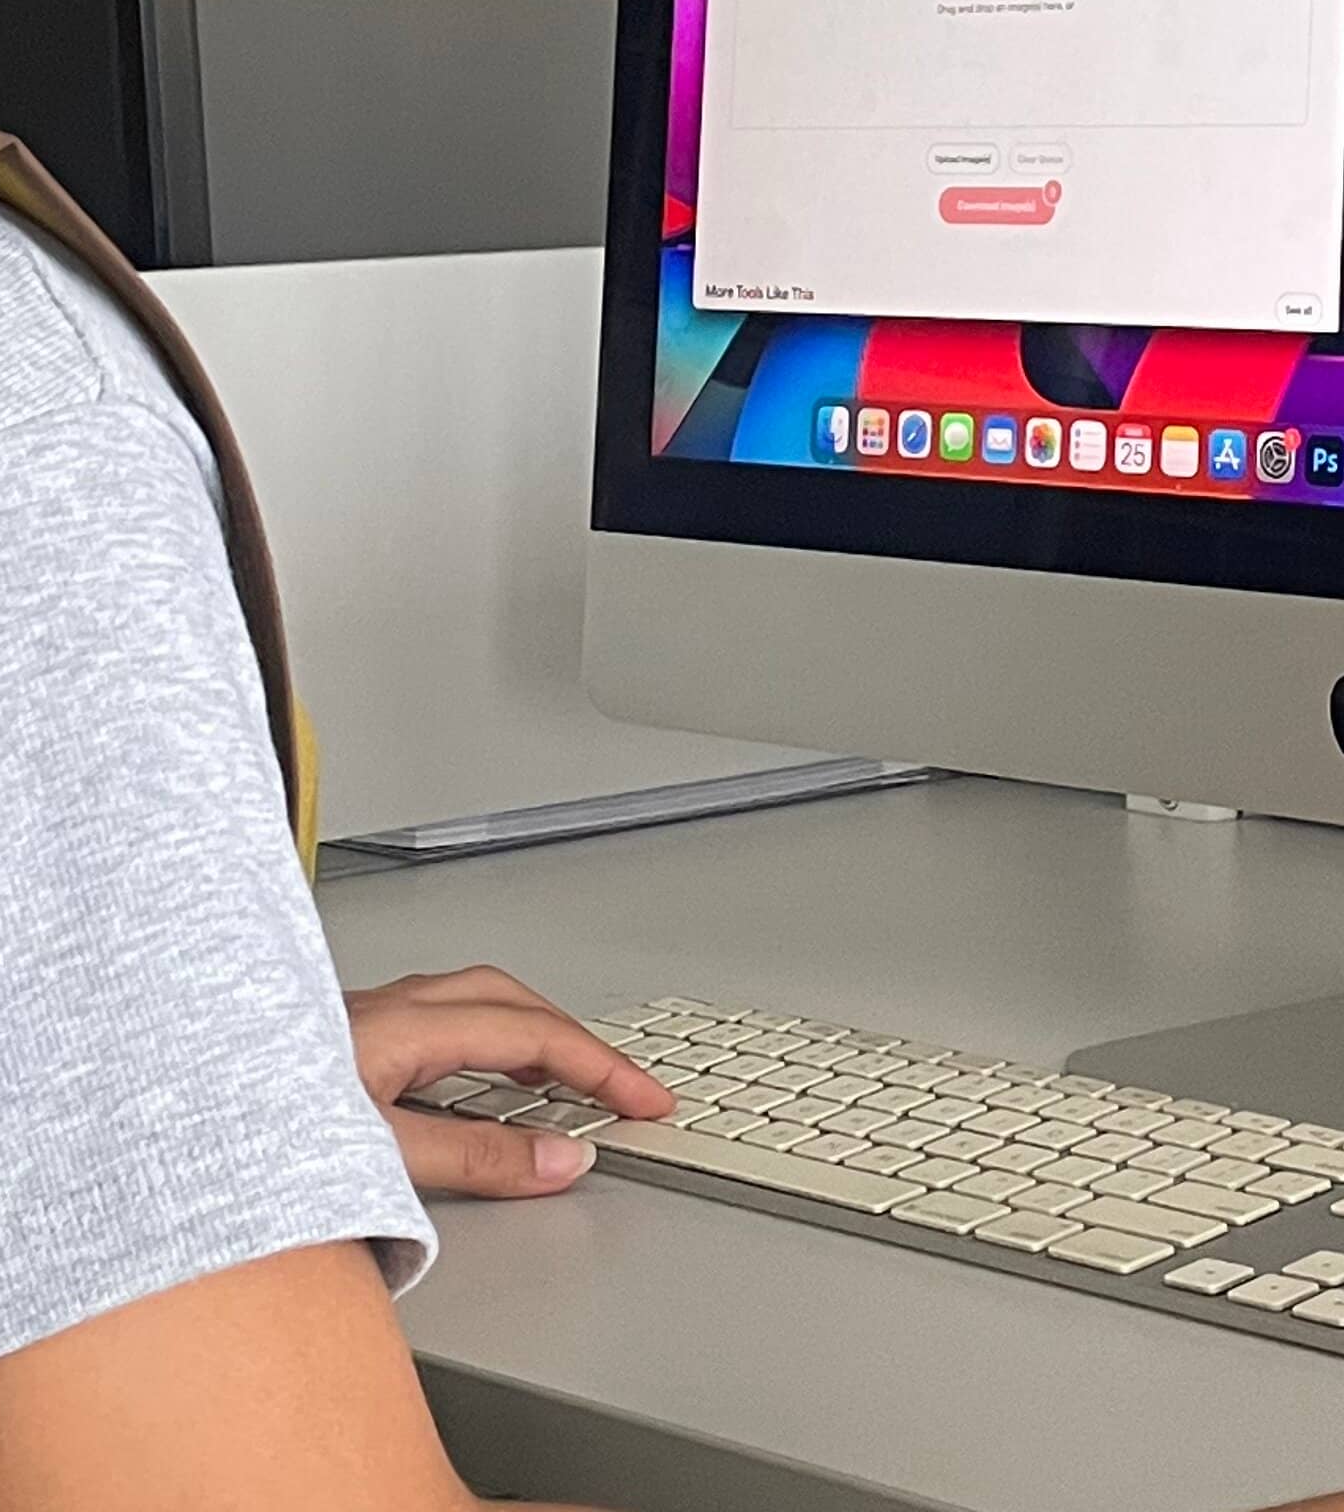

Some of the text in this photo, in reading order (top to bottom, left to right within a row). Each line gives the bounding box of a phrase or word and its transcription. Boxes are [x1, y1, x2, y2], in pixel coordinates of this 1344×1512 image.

[705, 283, 815, 301] More Tools Like This
[1120, 441, 1146, 467] 25
[1313, 448, 1338, 473] Ps
